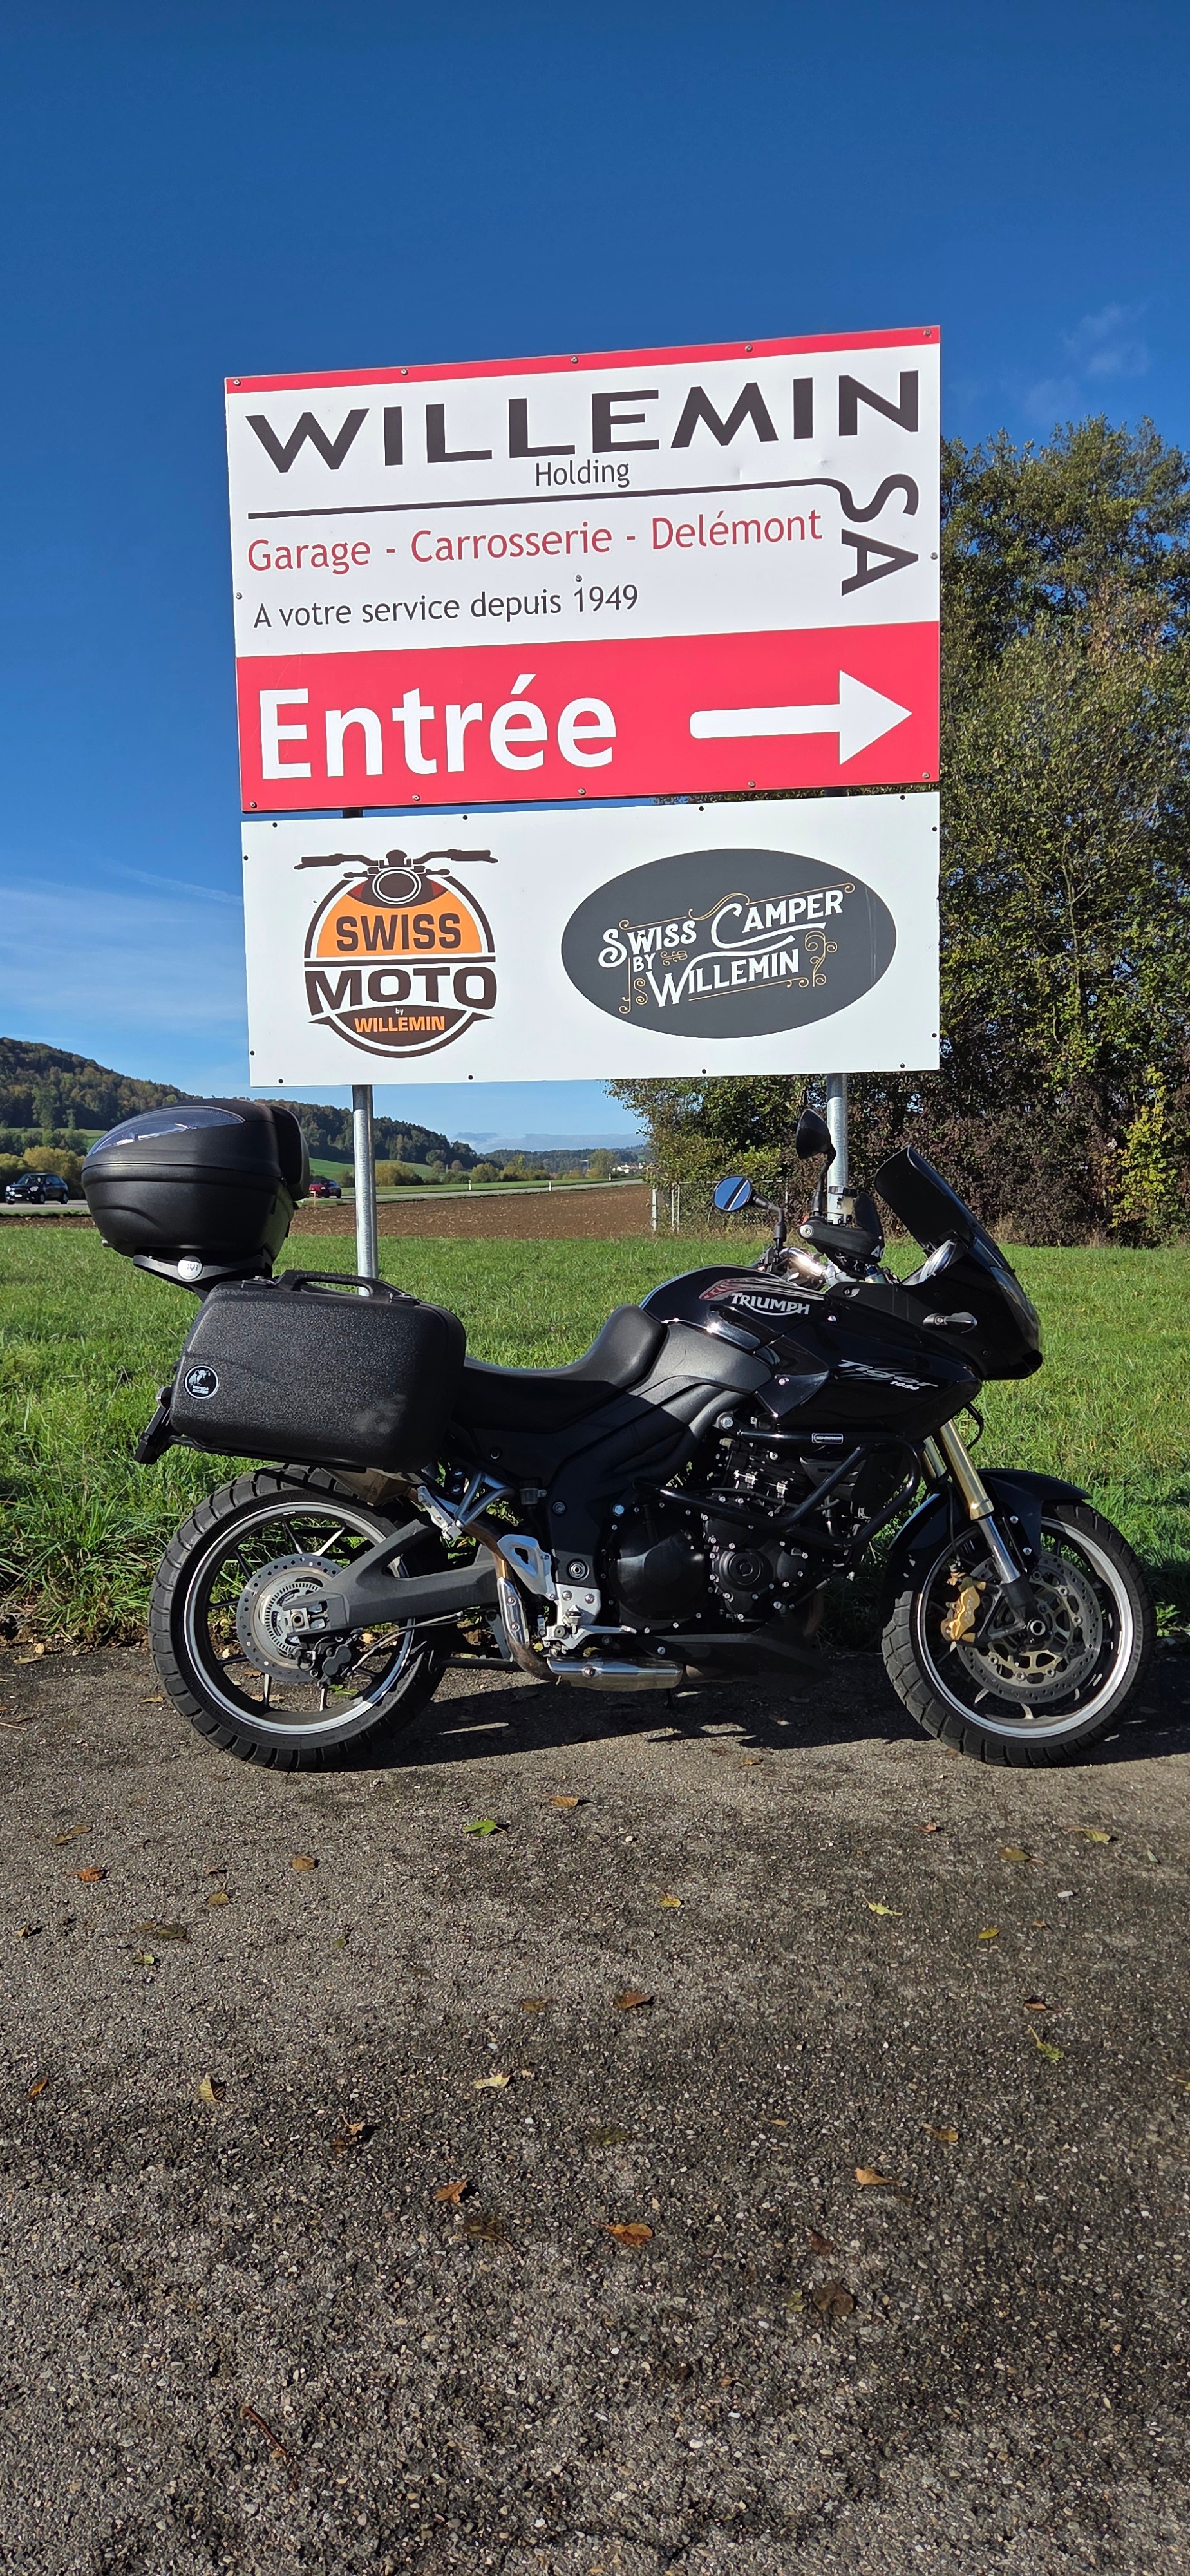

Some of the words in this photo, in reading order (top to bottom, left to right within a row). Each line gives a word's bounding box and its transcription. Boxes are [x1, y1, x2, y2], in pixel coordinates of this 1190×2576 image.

[245, 370, 919, 473] WILLEMIN
[535, 459, 630, 488] Holding
[248, 539, 371, 574] Garage
[411, 521, 612, 564] Carrosserie
[652, 509, 823, 550] Delémont
[840, 473, 919, 597] SA
[253, 603, 272, 629] A
[279, 601, 352, 627] votre
[362, 594, 460, 624] service
[470, 589, 562, 623] depuis
[574, 583, 639, 612] 1949
[259, 673, 617, 780] Entrée
[335, 912, 462, 952] SWISS
[632, 952, 656, 974] BY
[305, 966, 498, 1016] MOTO
[354, 1016, 446, 1033] WILLEMIN
[395, 1007, 404, 1016] by
[730, 1292, 811, 1316] TRIUMPH
[838, 1359, 939, 1387] Tiger
[889, 1381, 920, 1390] 1050
